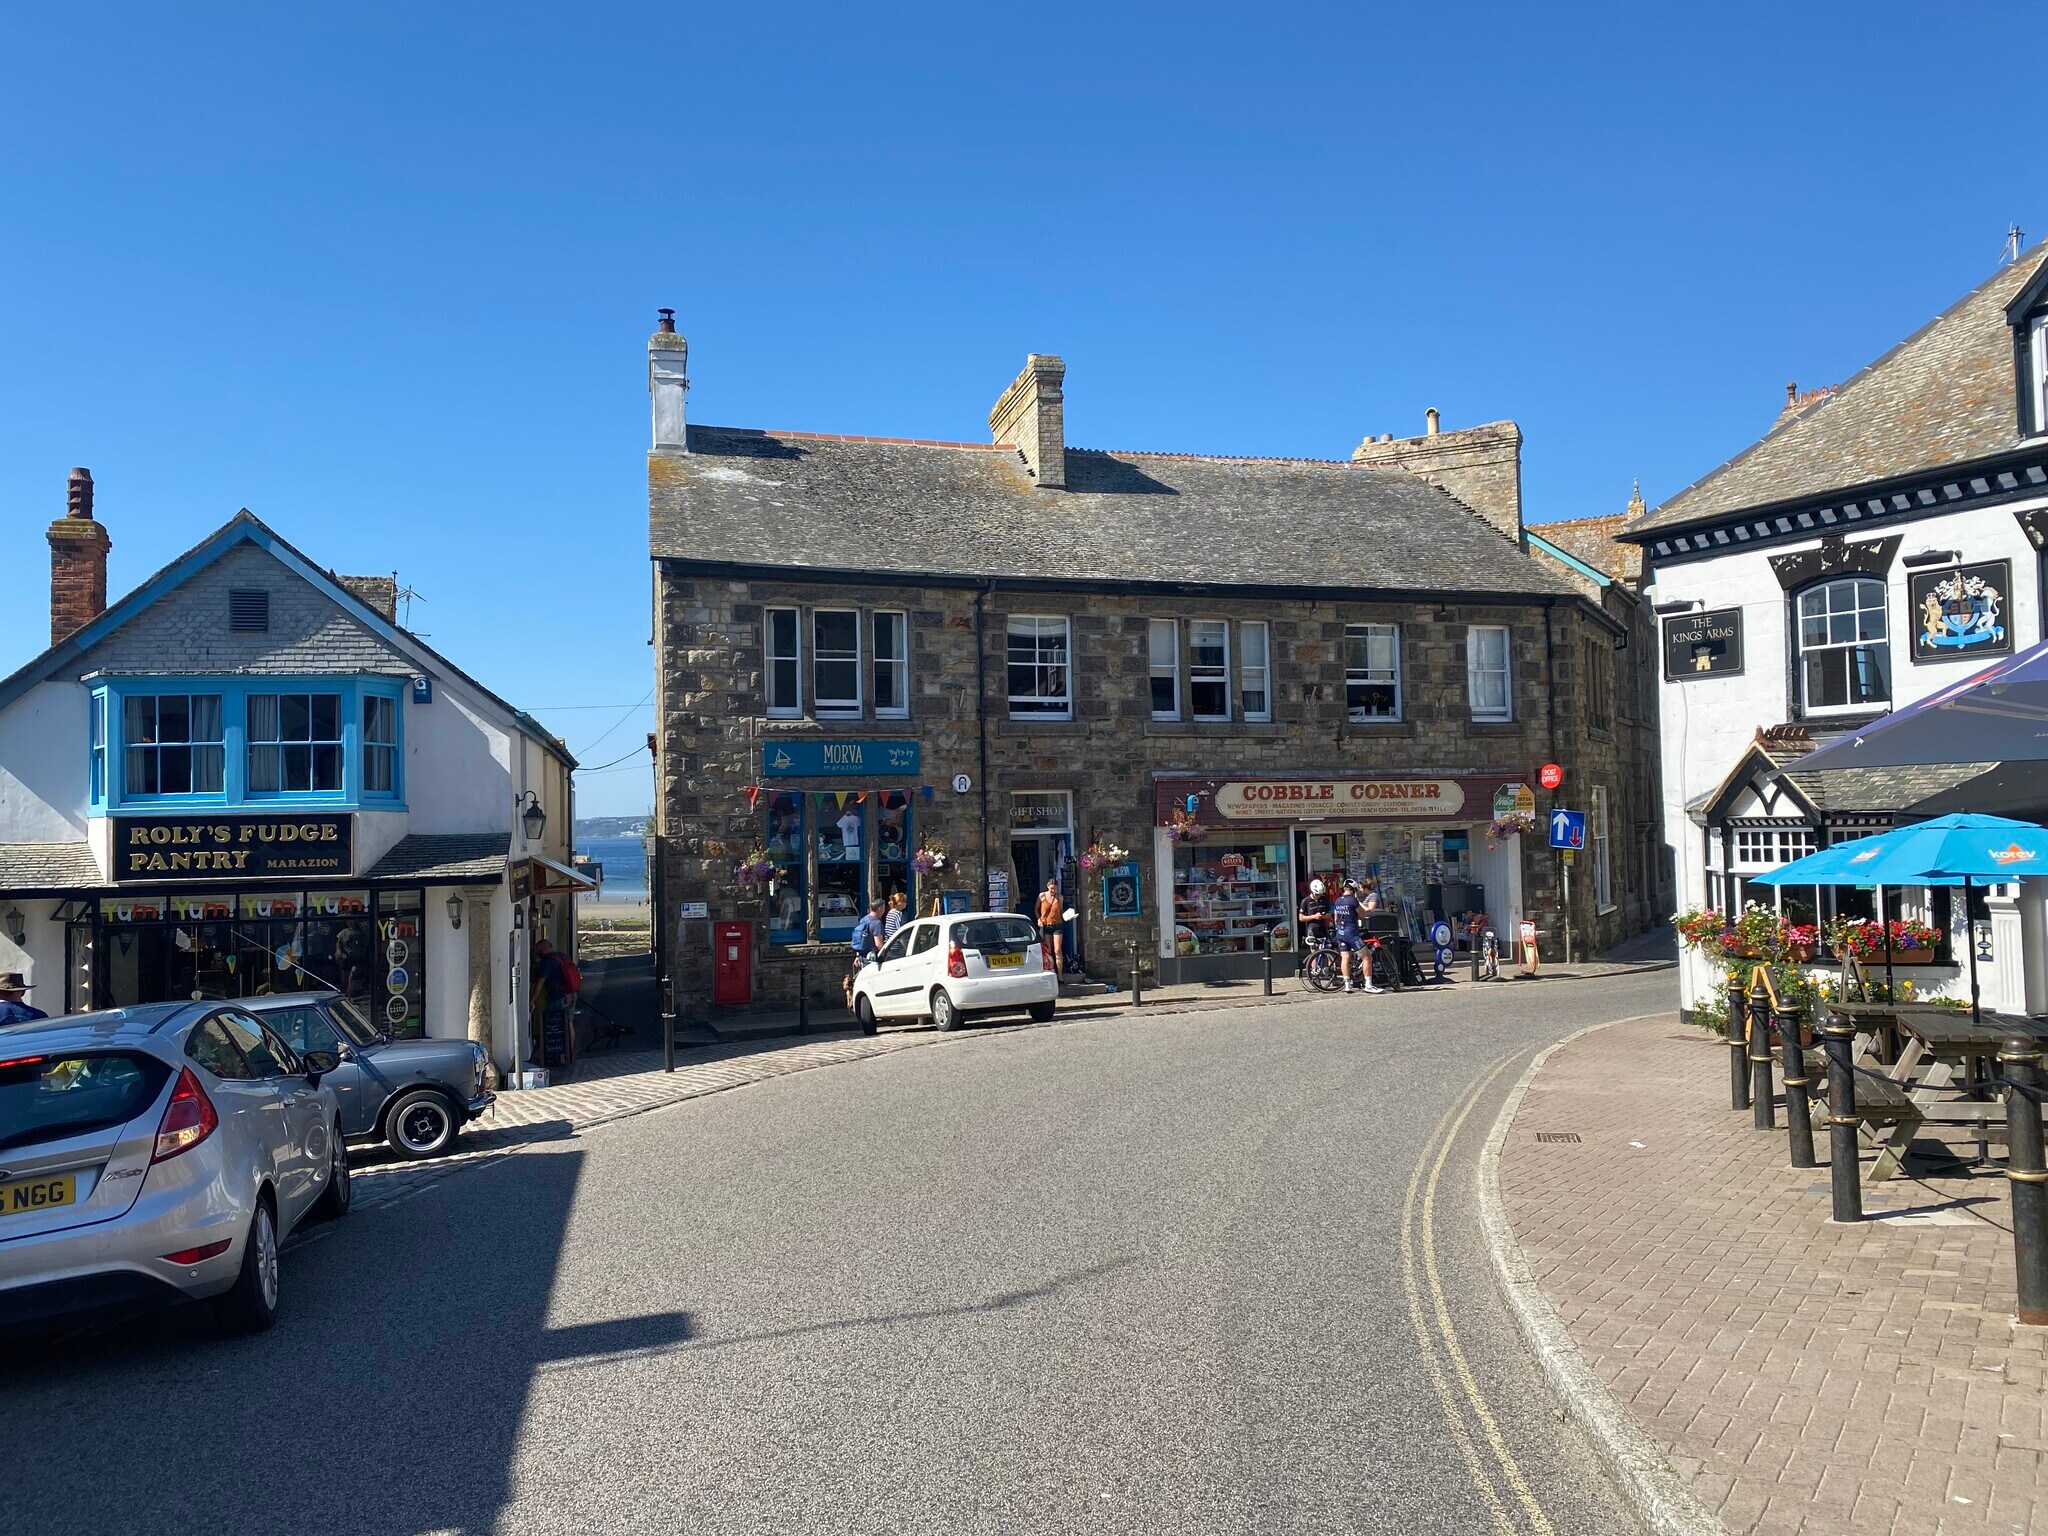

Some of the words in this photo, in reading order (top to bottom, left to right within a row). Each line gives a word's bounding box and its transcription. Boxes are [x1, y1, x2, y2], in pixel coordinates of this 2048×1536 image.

[1692, 617, 1713, 629] THE
[1673, 630, 1703, 644] KINGS
[1706, 627, 1734, 639] ARMS
[823, 744, 863, 764] MORVA
[1542, 775, 1559, 783] OFFICE
[1544, 768, 1557, 776] POST
[1243, 784, 1335, 801] COBBLE
[1350, 783, 1441, 800] CORNER
[1009, 806, 1034, 817] GIFT
[1036, 806, 1064, 816] SHOP
[129, 824, 232, 845] ROLY'S
[238, 823, 338, 843] FUDGE
[129, 850, 250, 871] PANTRY
[267, 858, 339, 869] MARAZION
[1988, 849, 2036, 859] korev
[104, 900, 165, 922] Yum!
[174, 898, 235, 920] Yum!
[243, 897, 303, 918] Yum!
[310, 893, 370, 914] Yum!
[377, 917, 420, 941] Yum!
[13, 1181, 64, 1210] NGG
